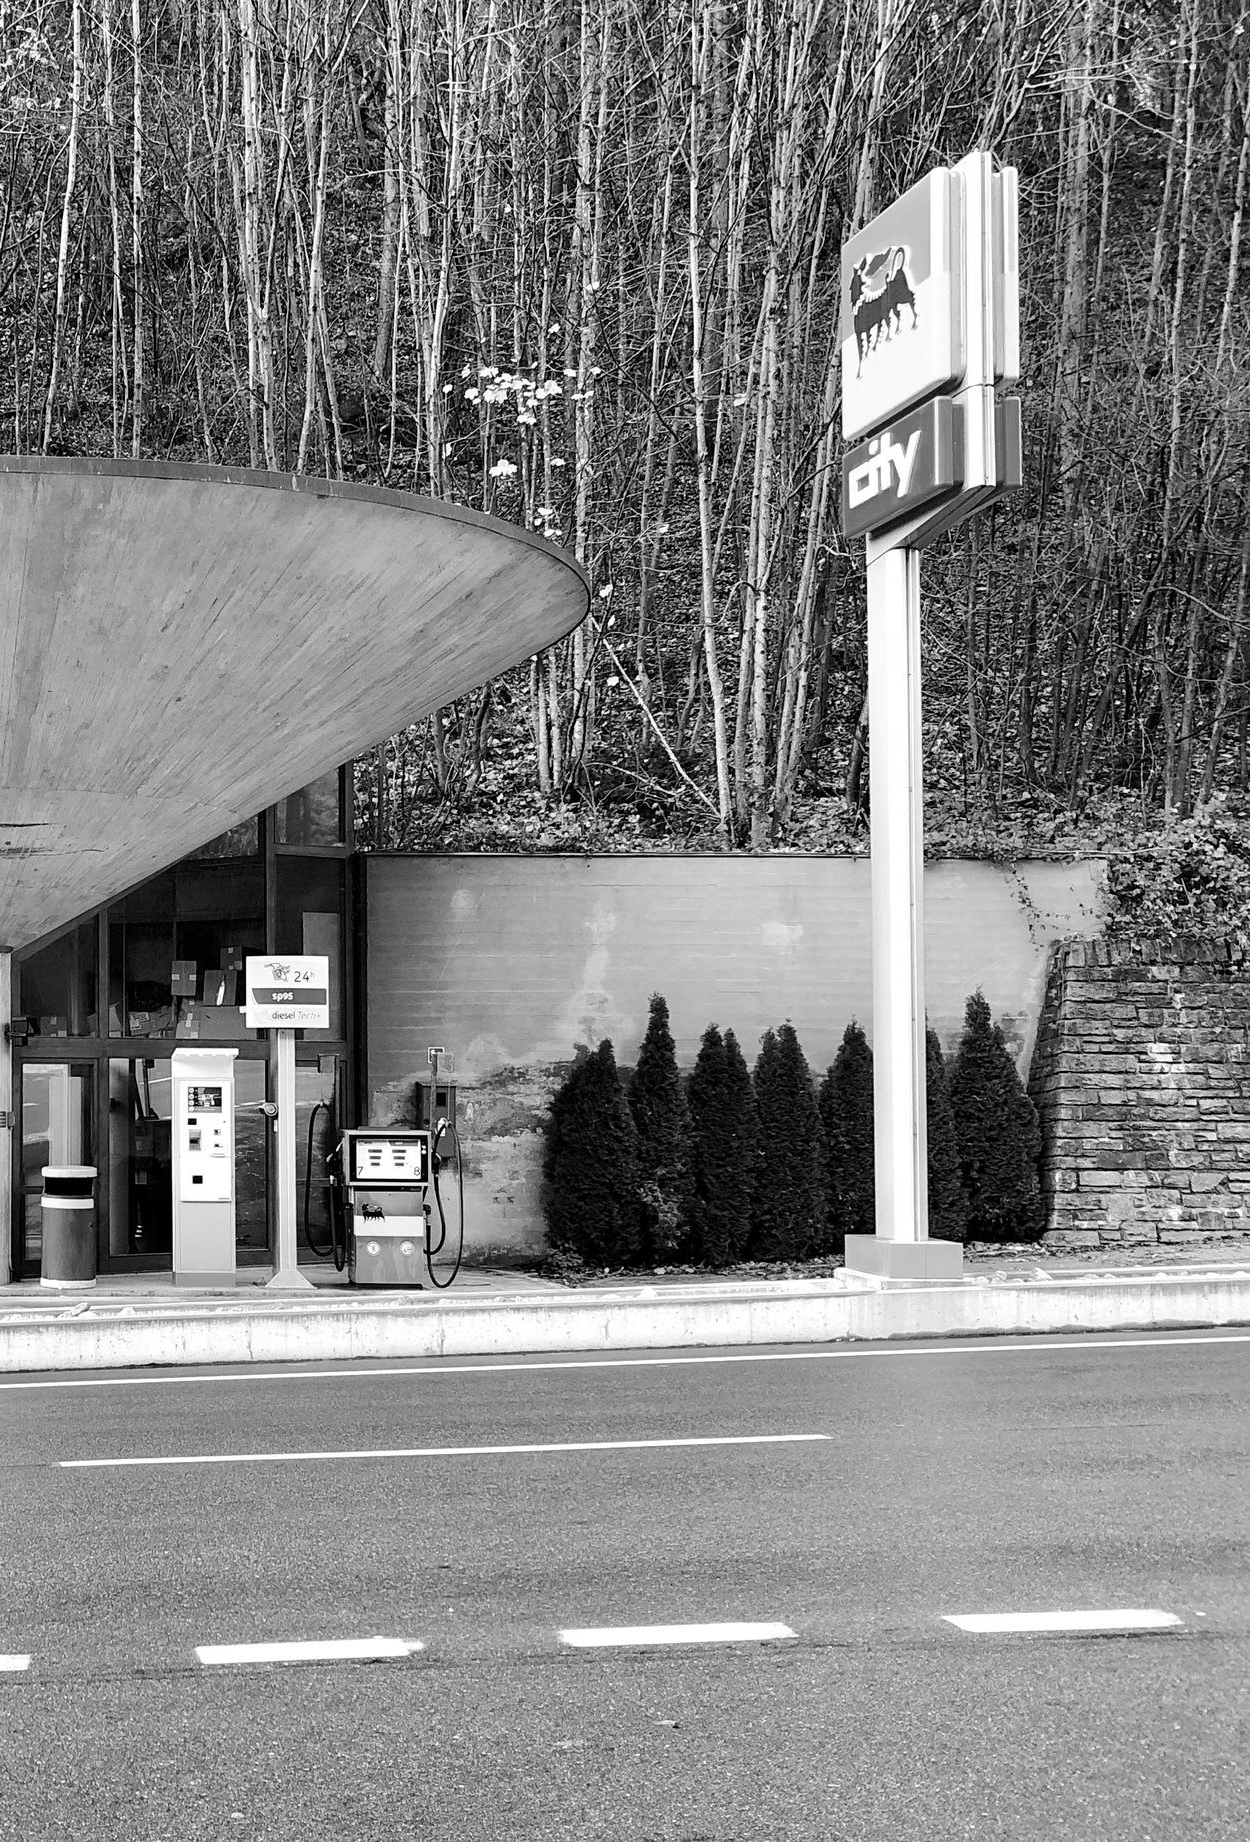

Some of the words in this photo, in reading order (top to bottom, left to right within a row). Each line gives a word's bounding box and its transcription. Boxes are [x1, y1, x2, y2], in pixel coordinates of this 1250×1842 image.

[848, 430, 922, 509] city
[293, 970, 314, 983] 24h
[272, 992, 294, 1002] sp95
[272, 1010, 296, 1020] diesel
[298, 1010, 321, 1020] Tech+
[357, 1166, 364, 1176] 7
[413, 1166, 421, 1176] 8
